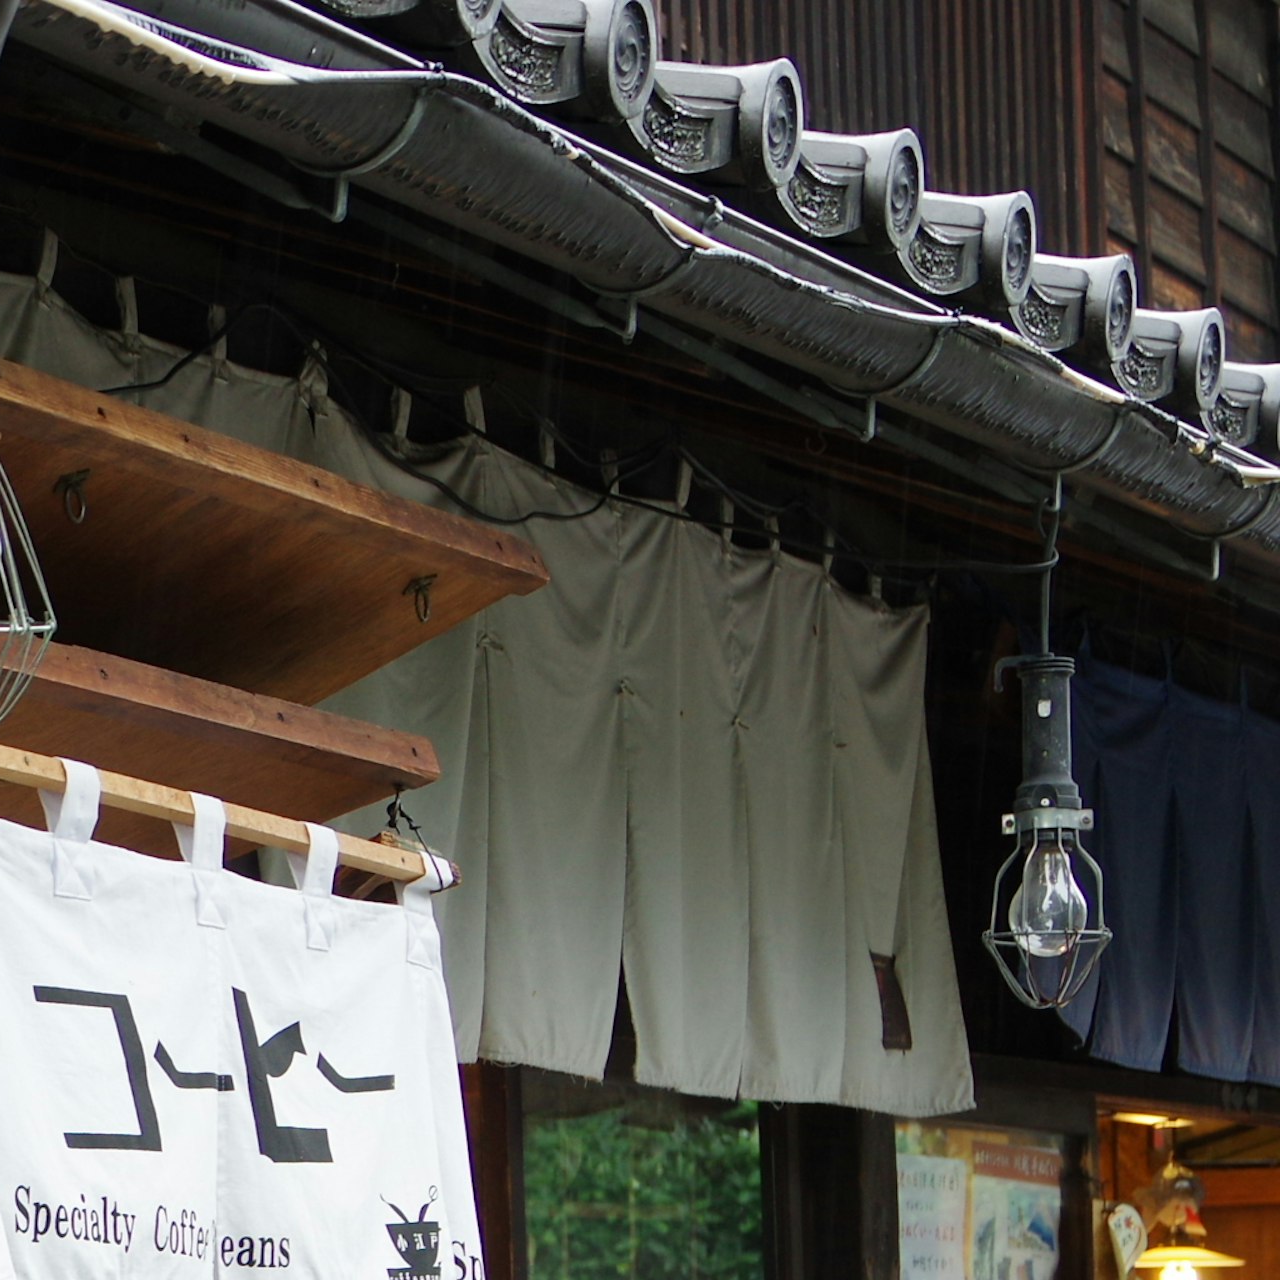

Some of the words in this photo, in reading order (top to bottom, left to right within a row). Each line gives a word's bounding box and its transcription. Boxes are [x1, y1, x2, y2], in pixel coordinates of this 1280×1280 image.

[32, 985, 395, 1164] コーヒー
[14, 1184, 136, 1254] Specialty
[154, 1204, 209, 1260] Coffe
[216, 1226, 291, 1268] eans
